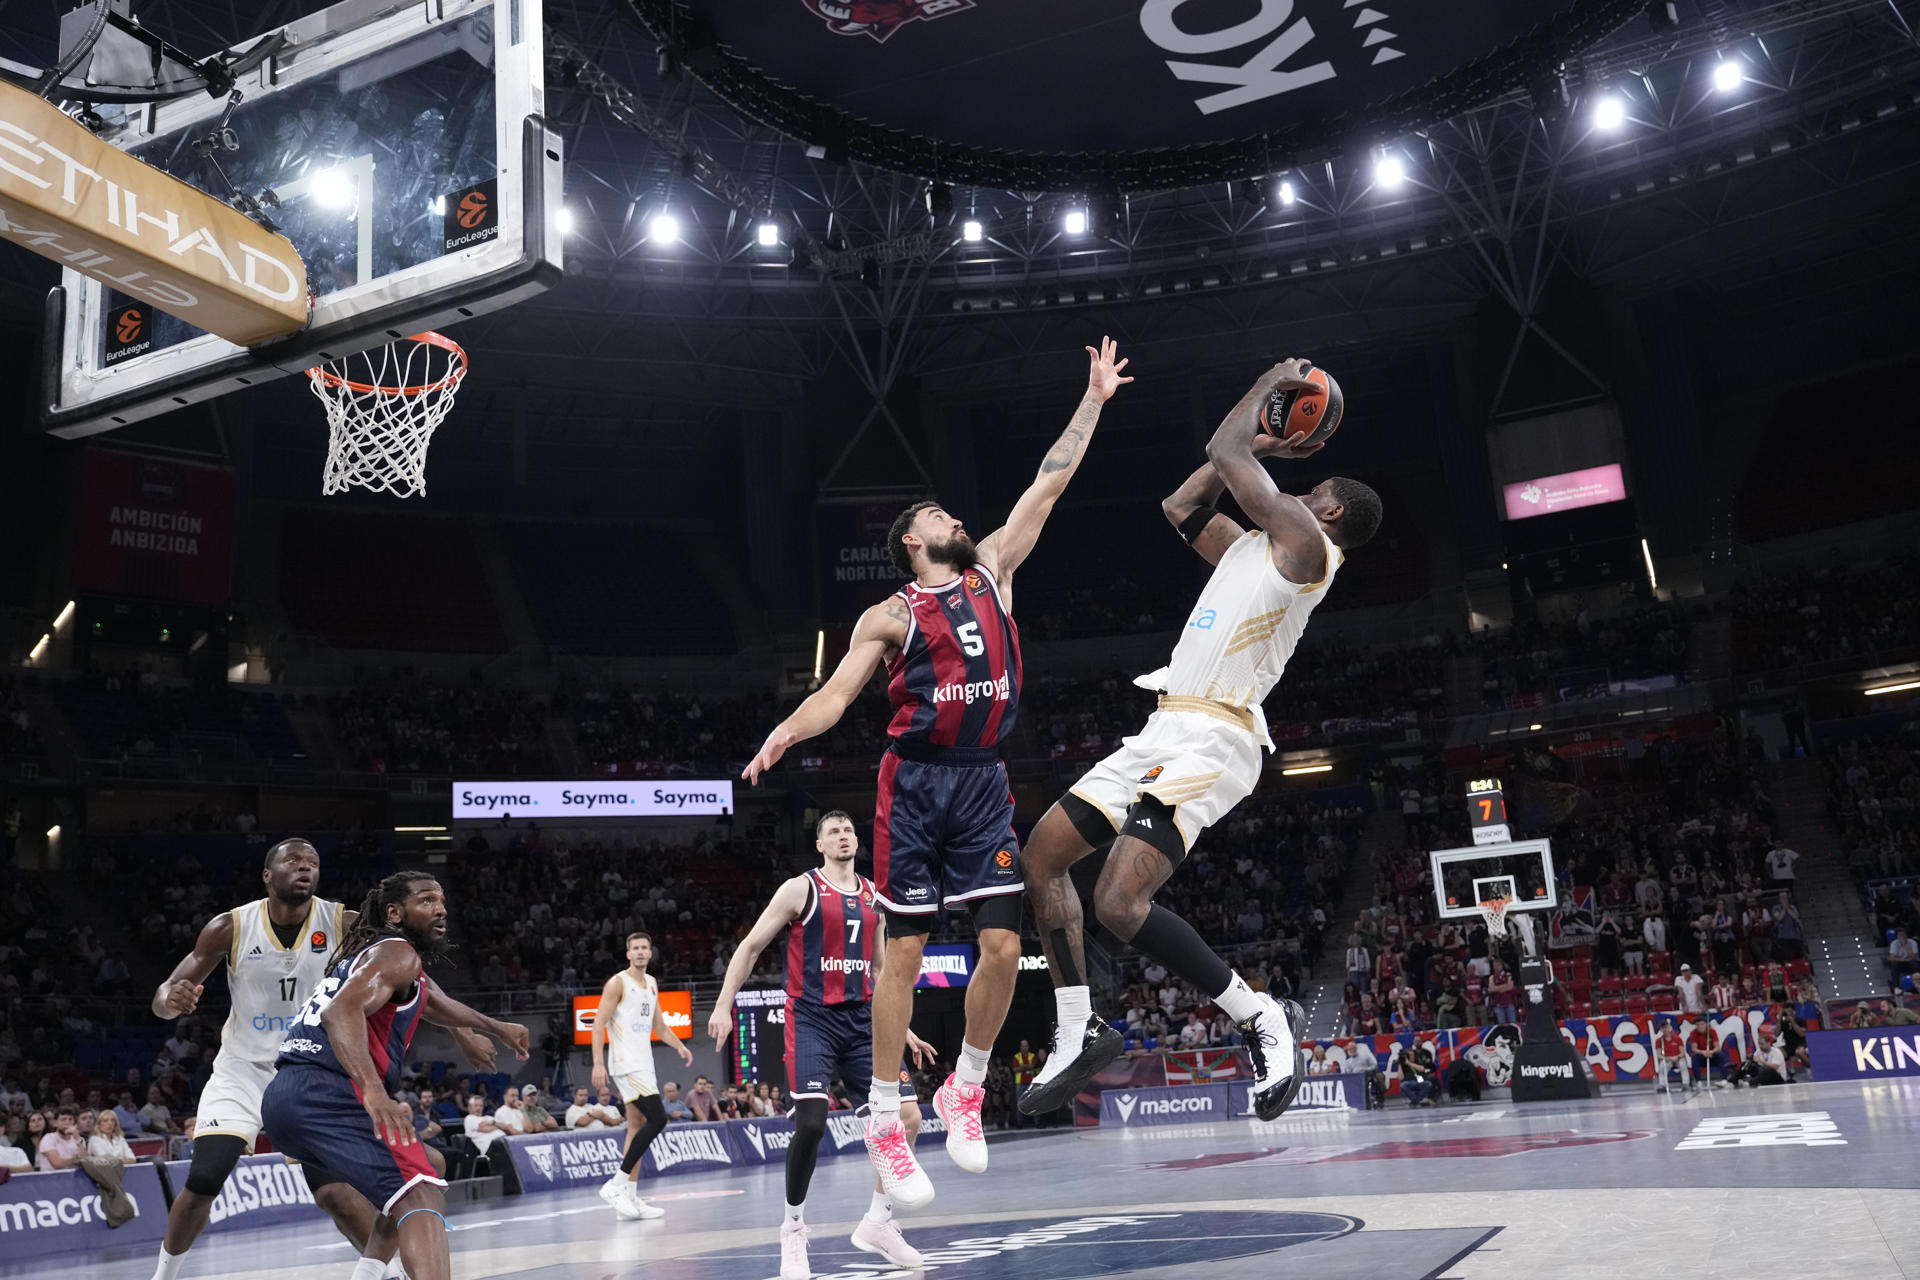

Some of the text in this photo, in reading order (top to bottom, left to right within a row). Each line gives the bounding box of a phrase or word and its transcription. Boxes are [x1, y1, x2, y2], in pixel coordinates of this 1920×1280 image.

[0, 122, 299, 303] ETIHAD
[446, 225, 499, 249] EuroLeague
[106, 341, 150, 362] EuroLeague
[1271, 390, 1288, 429] SPALD
[110, 506, 202, 535] AMBICIÓN
[110, 528, 199, 557] ANBIZIOA
[840, 541, 891, 563] CARÁC
[835, 565, 897, 582] NORTAS
[956, 621, 984, 657] 5
[932, 669, 1010, 704] kingroyal
[462, 789, 726, 810] Sayma. Sayma. Sayma.
[1478, 799, 1492, 821] 7
[905, 887, 927, 896] Jeep
[846, 919, 861, 943] 7
[820, 956, 871, 977] kingroy
[278, 977, 297, 1001] 17
[253, 1013, 296, 1032] dna
[1521, 1062, 1574, 1078] kingroyal
[1138, 1096, 1212, 1115] macron
[559, 1137, 623, 1165] AMBAR
[649, 1129, 732, 1172] BASKONIA
[564, 1160, 623, 1179] TRIPLE ZER
